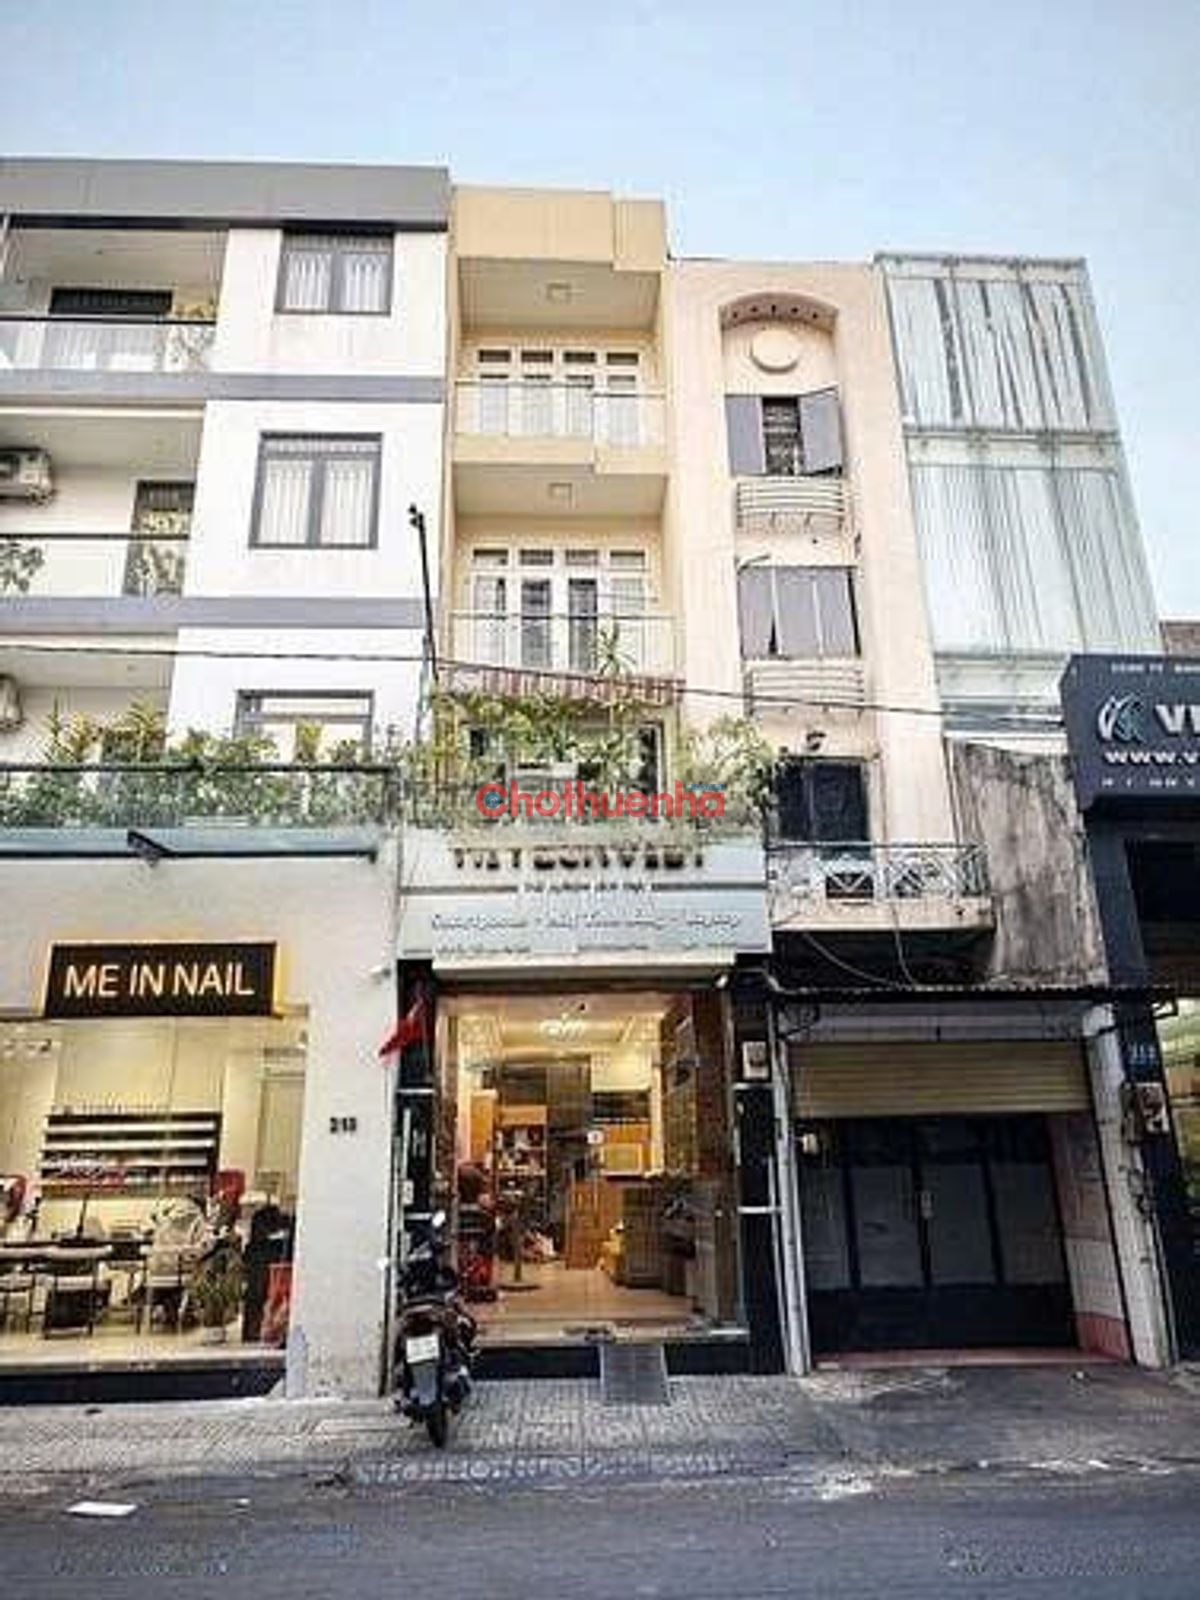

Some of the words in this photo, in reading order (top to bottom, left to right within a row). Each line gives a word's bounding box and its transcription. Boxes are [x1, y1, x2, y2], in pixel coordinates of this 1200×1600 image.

[64, 964, 120, 996] ME
[129, 963, 165, 996] IN
[172, 962, 255, 996] NAIL
